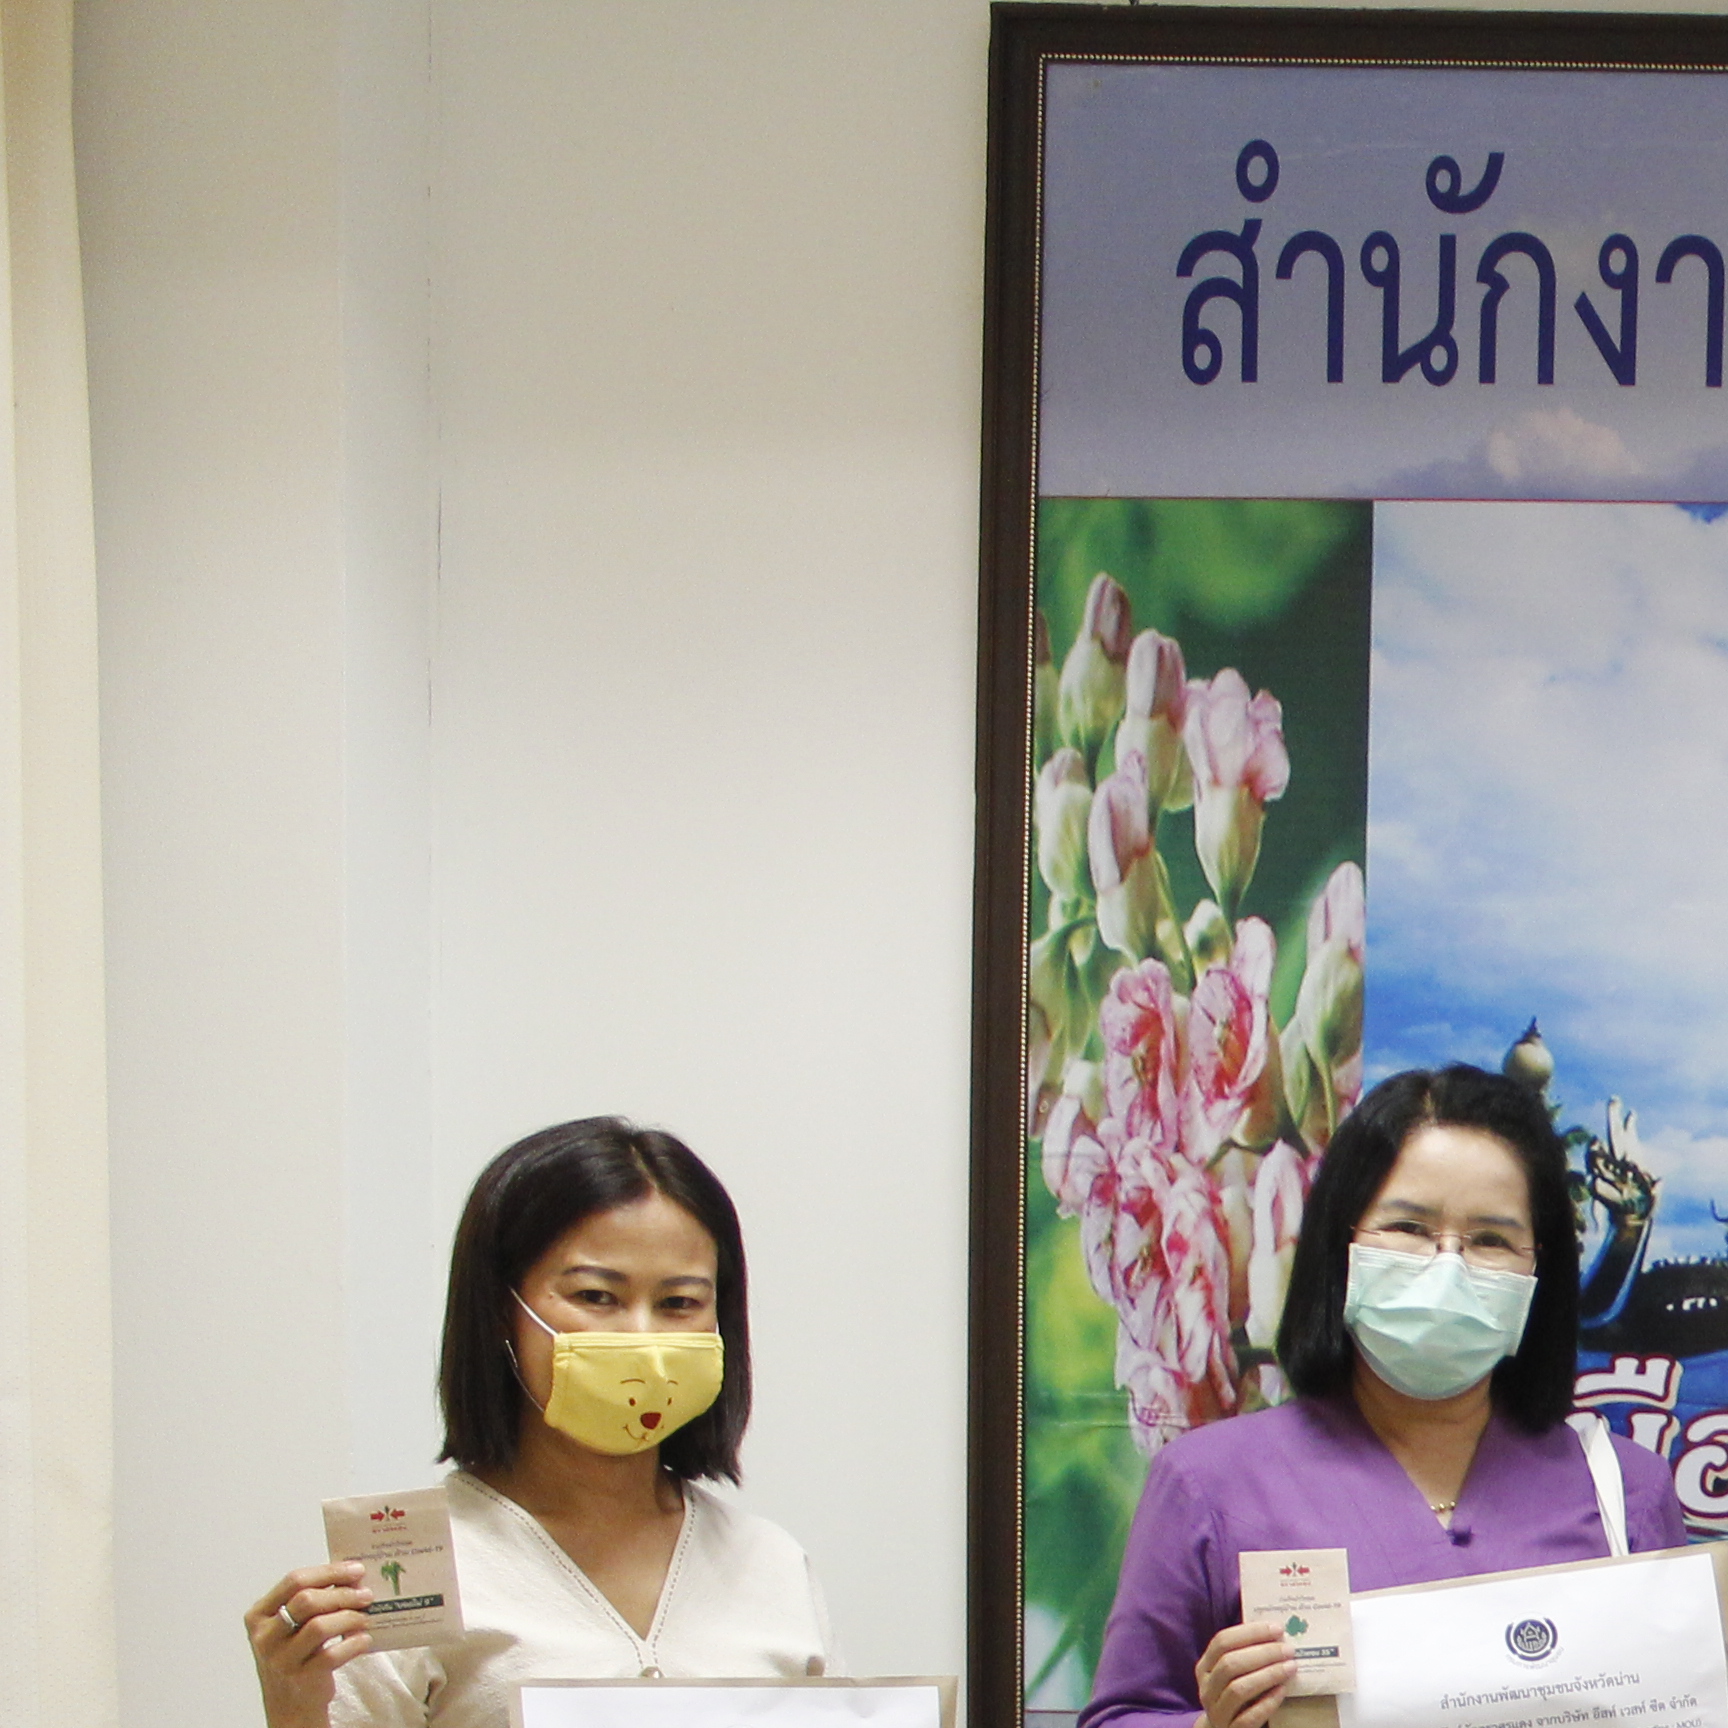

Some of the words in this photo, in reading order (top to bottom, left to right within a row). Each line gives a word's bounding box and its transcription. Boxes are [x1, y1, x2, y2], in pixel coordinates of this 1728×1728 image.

[1440, 1671, 1640, 1710] สำนักงานพัฒนาชุมชนจังหวัดน่าน
[1536, 1710, 1589, 1727] จากบริษัท
[1669, 1694, 1698, 1711] จำกัด
